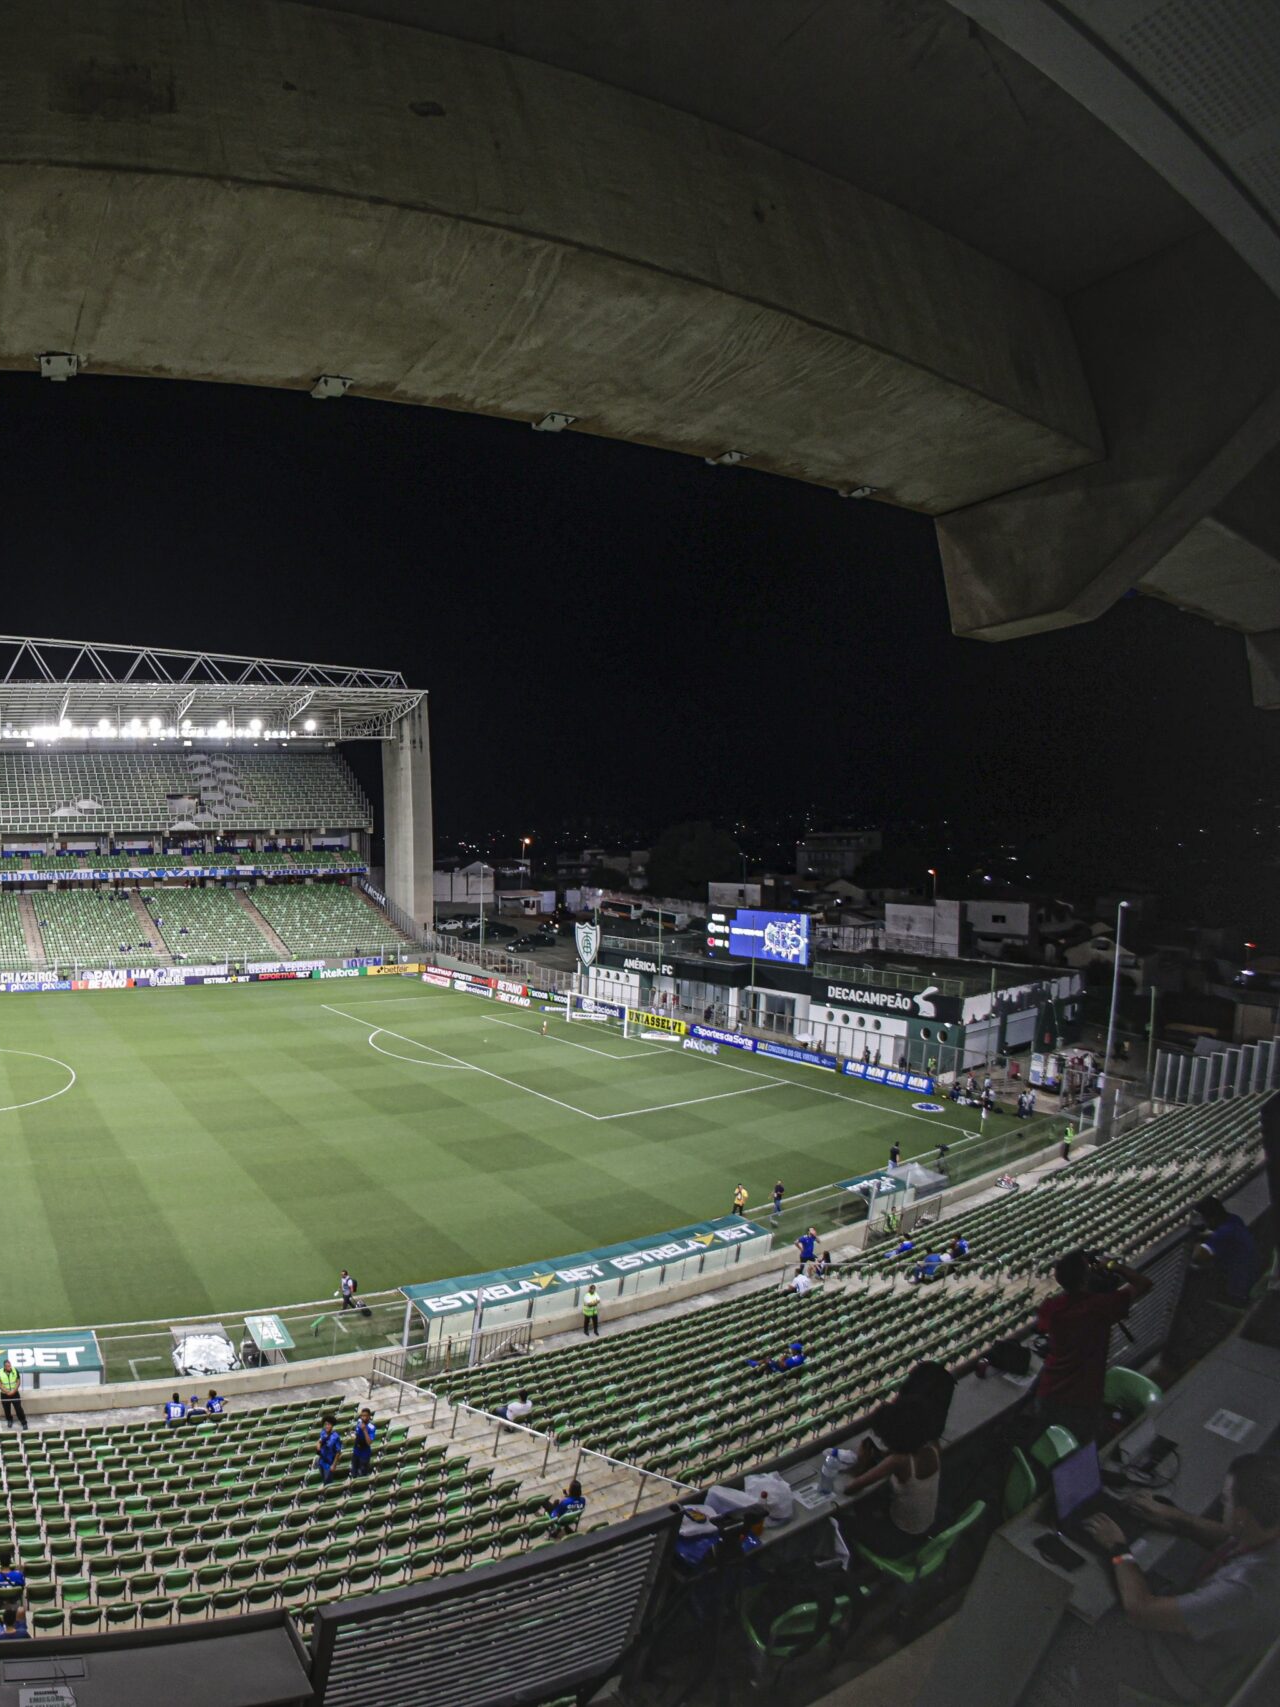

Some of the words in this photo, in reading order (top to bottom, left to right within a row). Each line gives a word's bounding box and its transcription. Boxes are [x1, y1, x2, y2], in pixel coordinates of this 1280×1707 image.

[384, 965, 408, 973] betfair
[623, 958, 656, 973] AMÉRICA
[662, 964, 673, 975] FC
[320, 968, 359, 979] intelbras
[89, 979, 126, 988] BETANO
[497, 980, 523, 994] BETANO
[501, 993, 530, 1006] BETANO
[827, 985, 911, 1011] DECACAMPEÃO
[629, 1012, 682, 1032] UNIASSELVI
[846, 1061, 864, 1073] MM
[866, 1066, 886, 1078] MM
[887, 1071, 906, 1083] MM
[908, 1076, 928, 1088] MM
[610, 1239, 704, 1270] ESTRELA
[714, 1223, 755, 1241] BET
[424, 1279, 542, 1312] ESTRELA
[556, 1263, 604, 1283] BET
[7, 1346, 86, 1368] BET
[170, 1407, 181, 1417] 10
